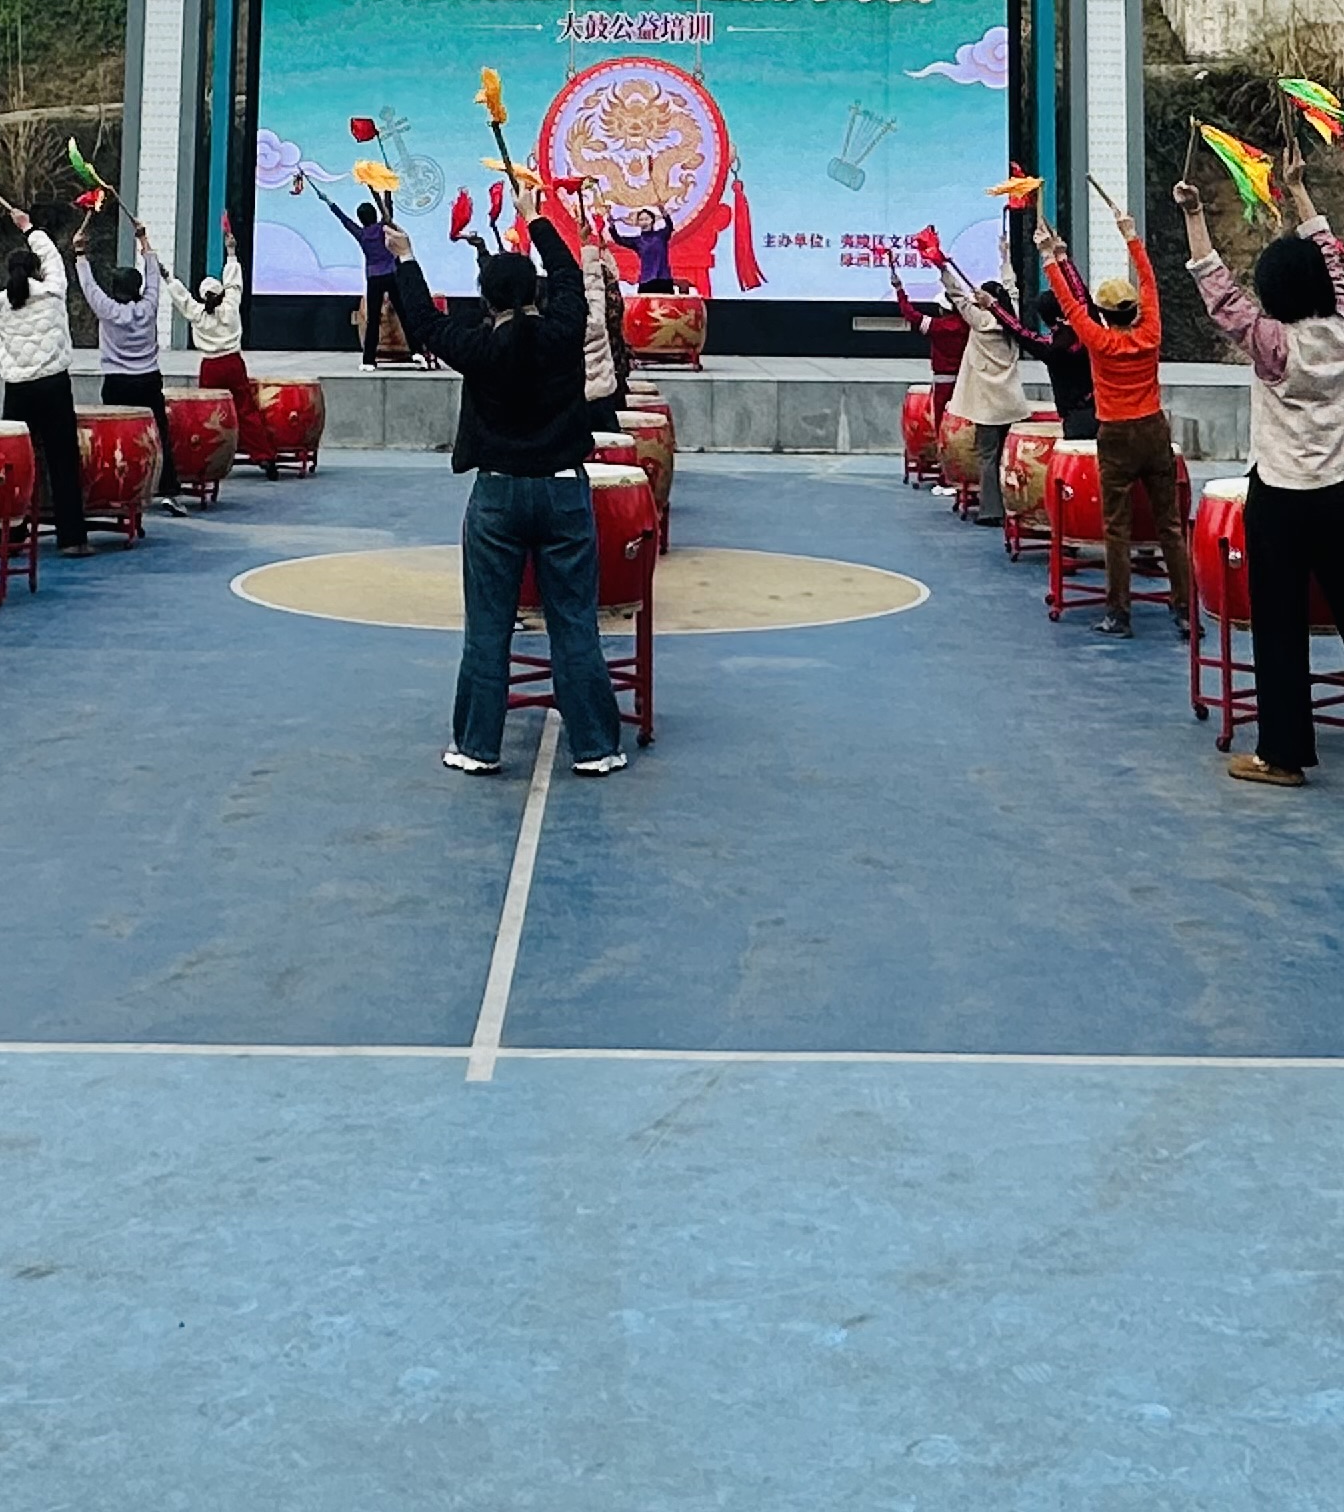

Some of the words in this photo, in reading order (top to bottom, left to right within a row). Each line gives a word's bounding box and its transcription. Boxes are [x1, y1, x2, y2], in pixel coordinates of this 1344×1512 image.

[558, 11, 713, 43] 大鼓公益培训
